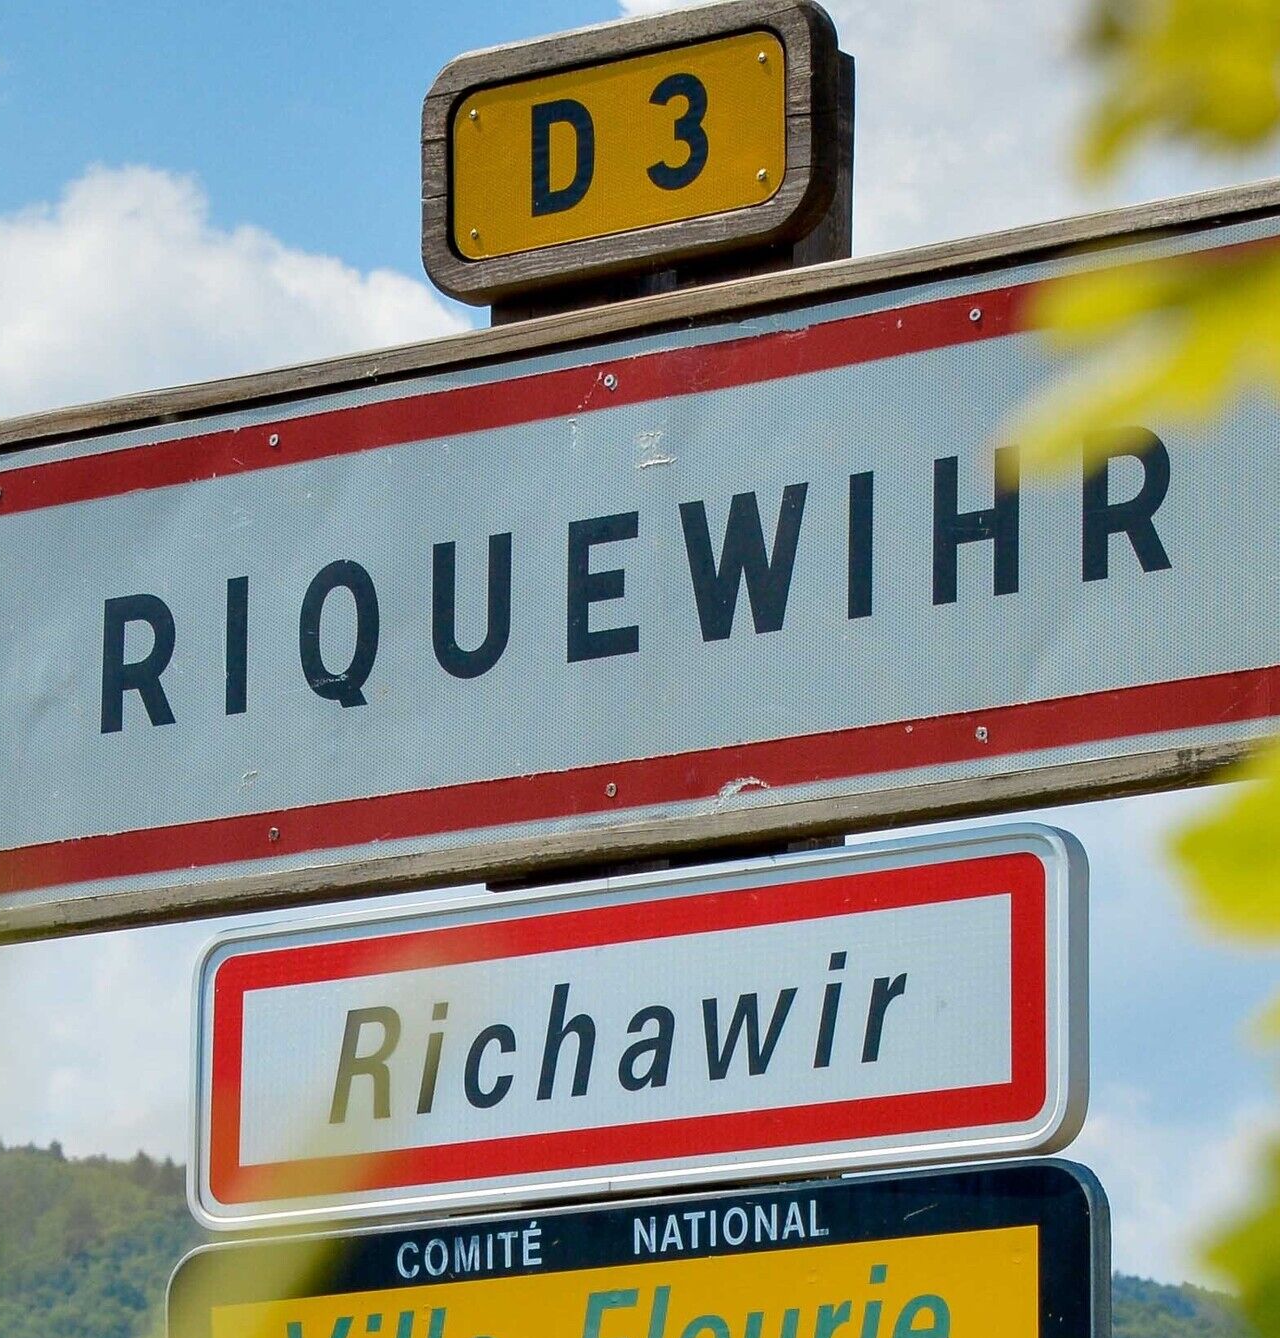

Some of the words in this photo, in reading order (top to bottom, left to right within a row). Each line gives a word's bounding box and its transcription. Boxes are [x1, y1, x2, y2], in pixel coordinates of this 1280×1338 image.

[531, 97, 594, 218] D
[648, 72, 710, 193] 3
[99, 425, 1173, 734] RIQUEWIHR
[328, 950, 909, 1125] Richawir
[396, 1220, 543, 1280] COMITÉ
[633, 1199, 829, 1255] NATIONAL
